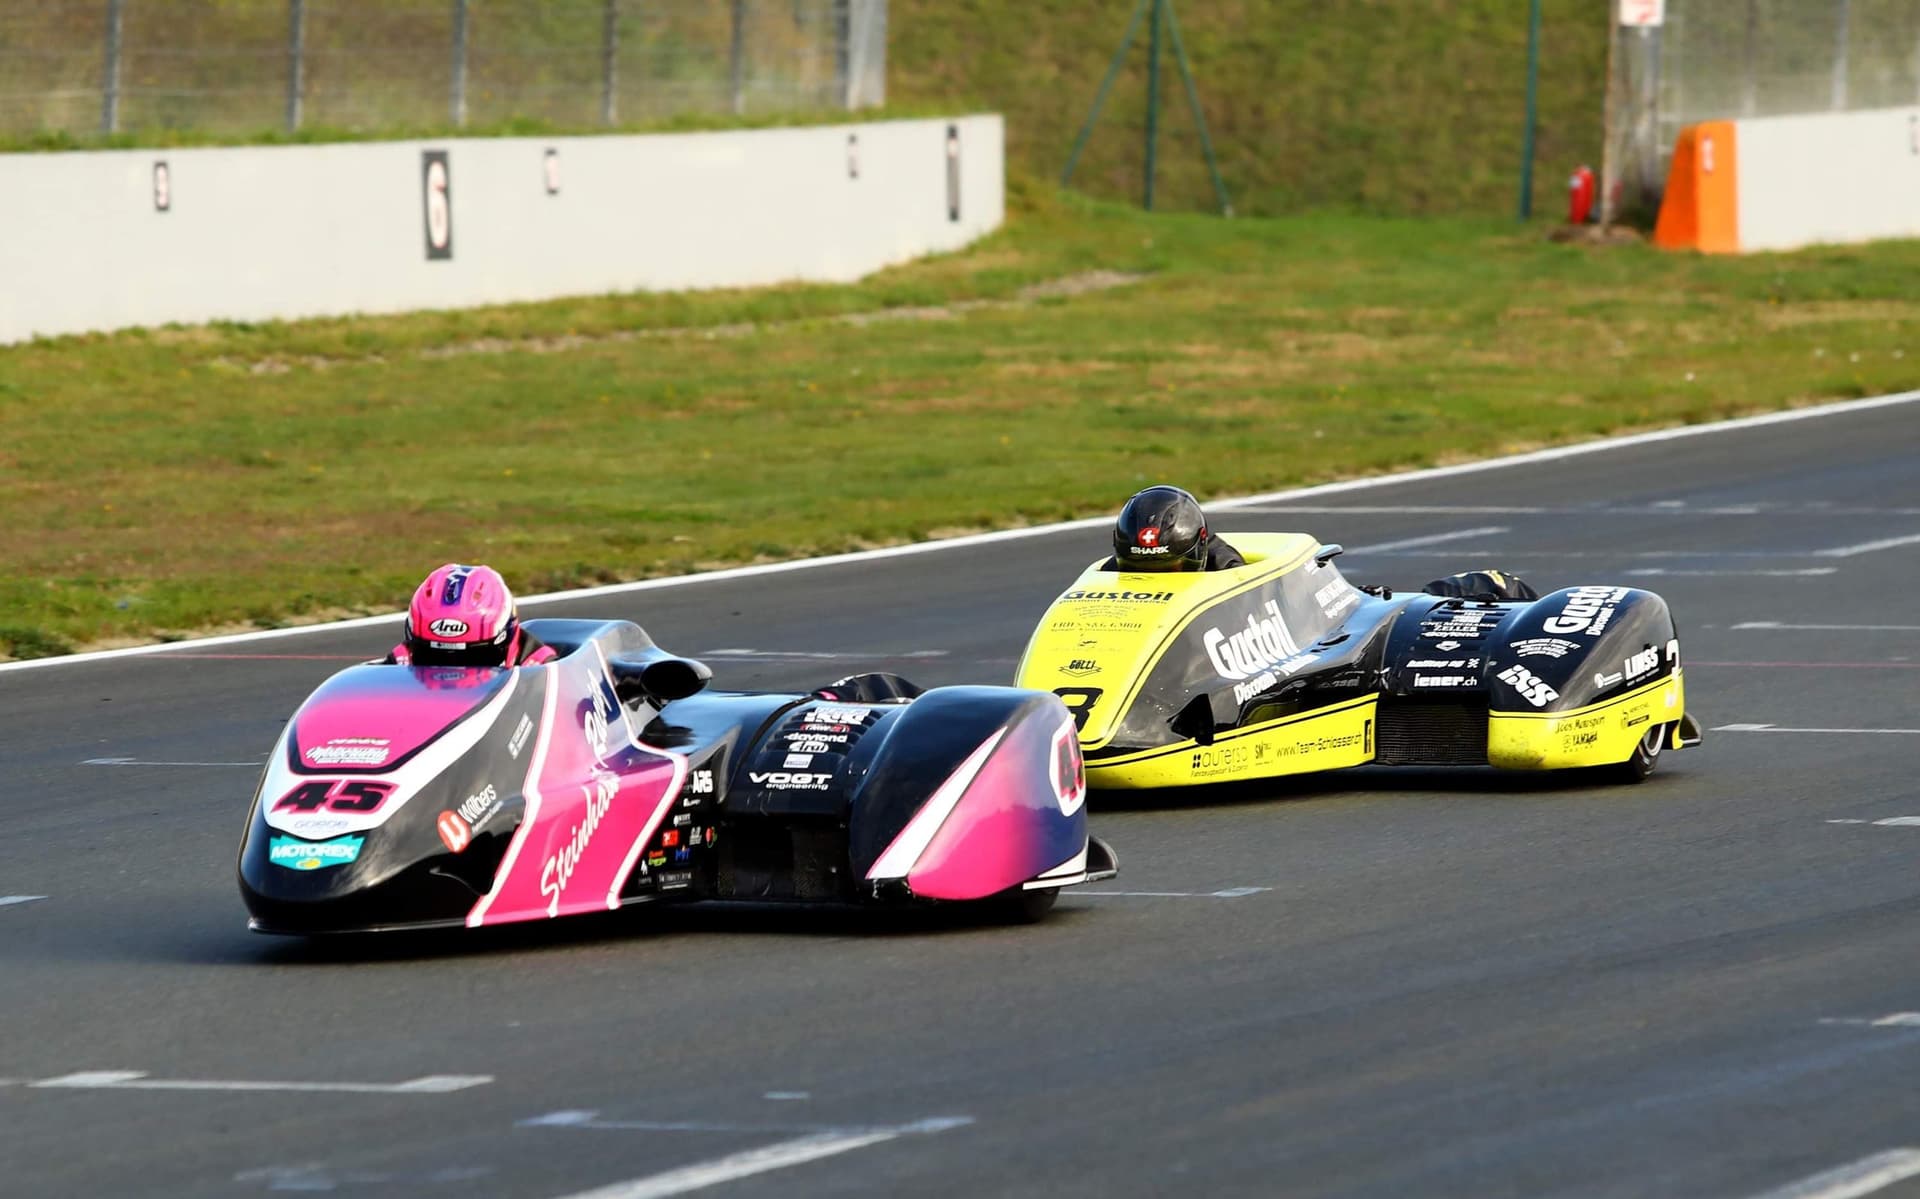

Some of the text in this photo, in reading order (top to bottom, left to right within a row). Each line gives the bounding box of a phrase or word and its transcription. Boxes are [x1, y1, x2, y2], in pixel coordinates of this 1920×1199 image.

[1130, 545, 1169, 555] SHARK
[1062, 591, 1174, 601] Gustoil
[434, 620, 465, 633] Arai
[1203, 599, 1301, 680] Gustoil
[749, 772, 833, 785] VOGT
[271, 780, 399, 814] 45
